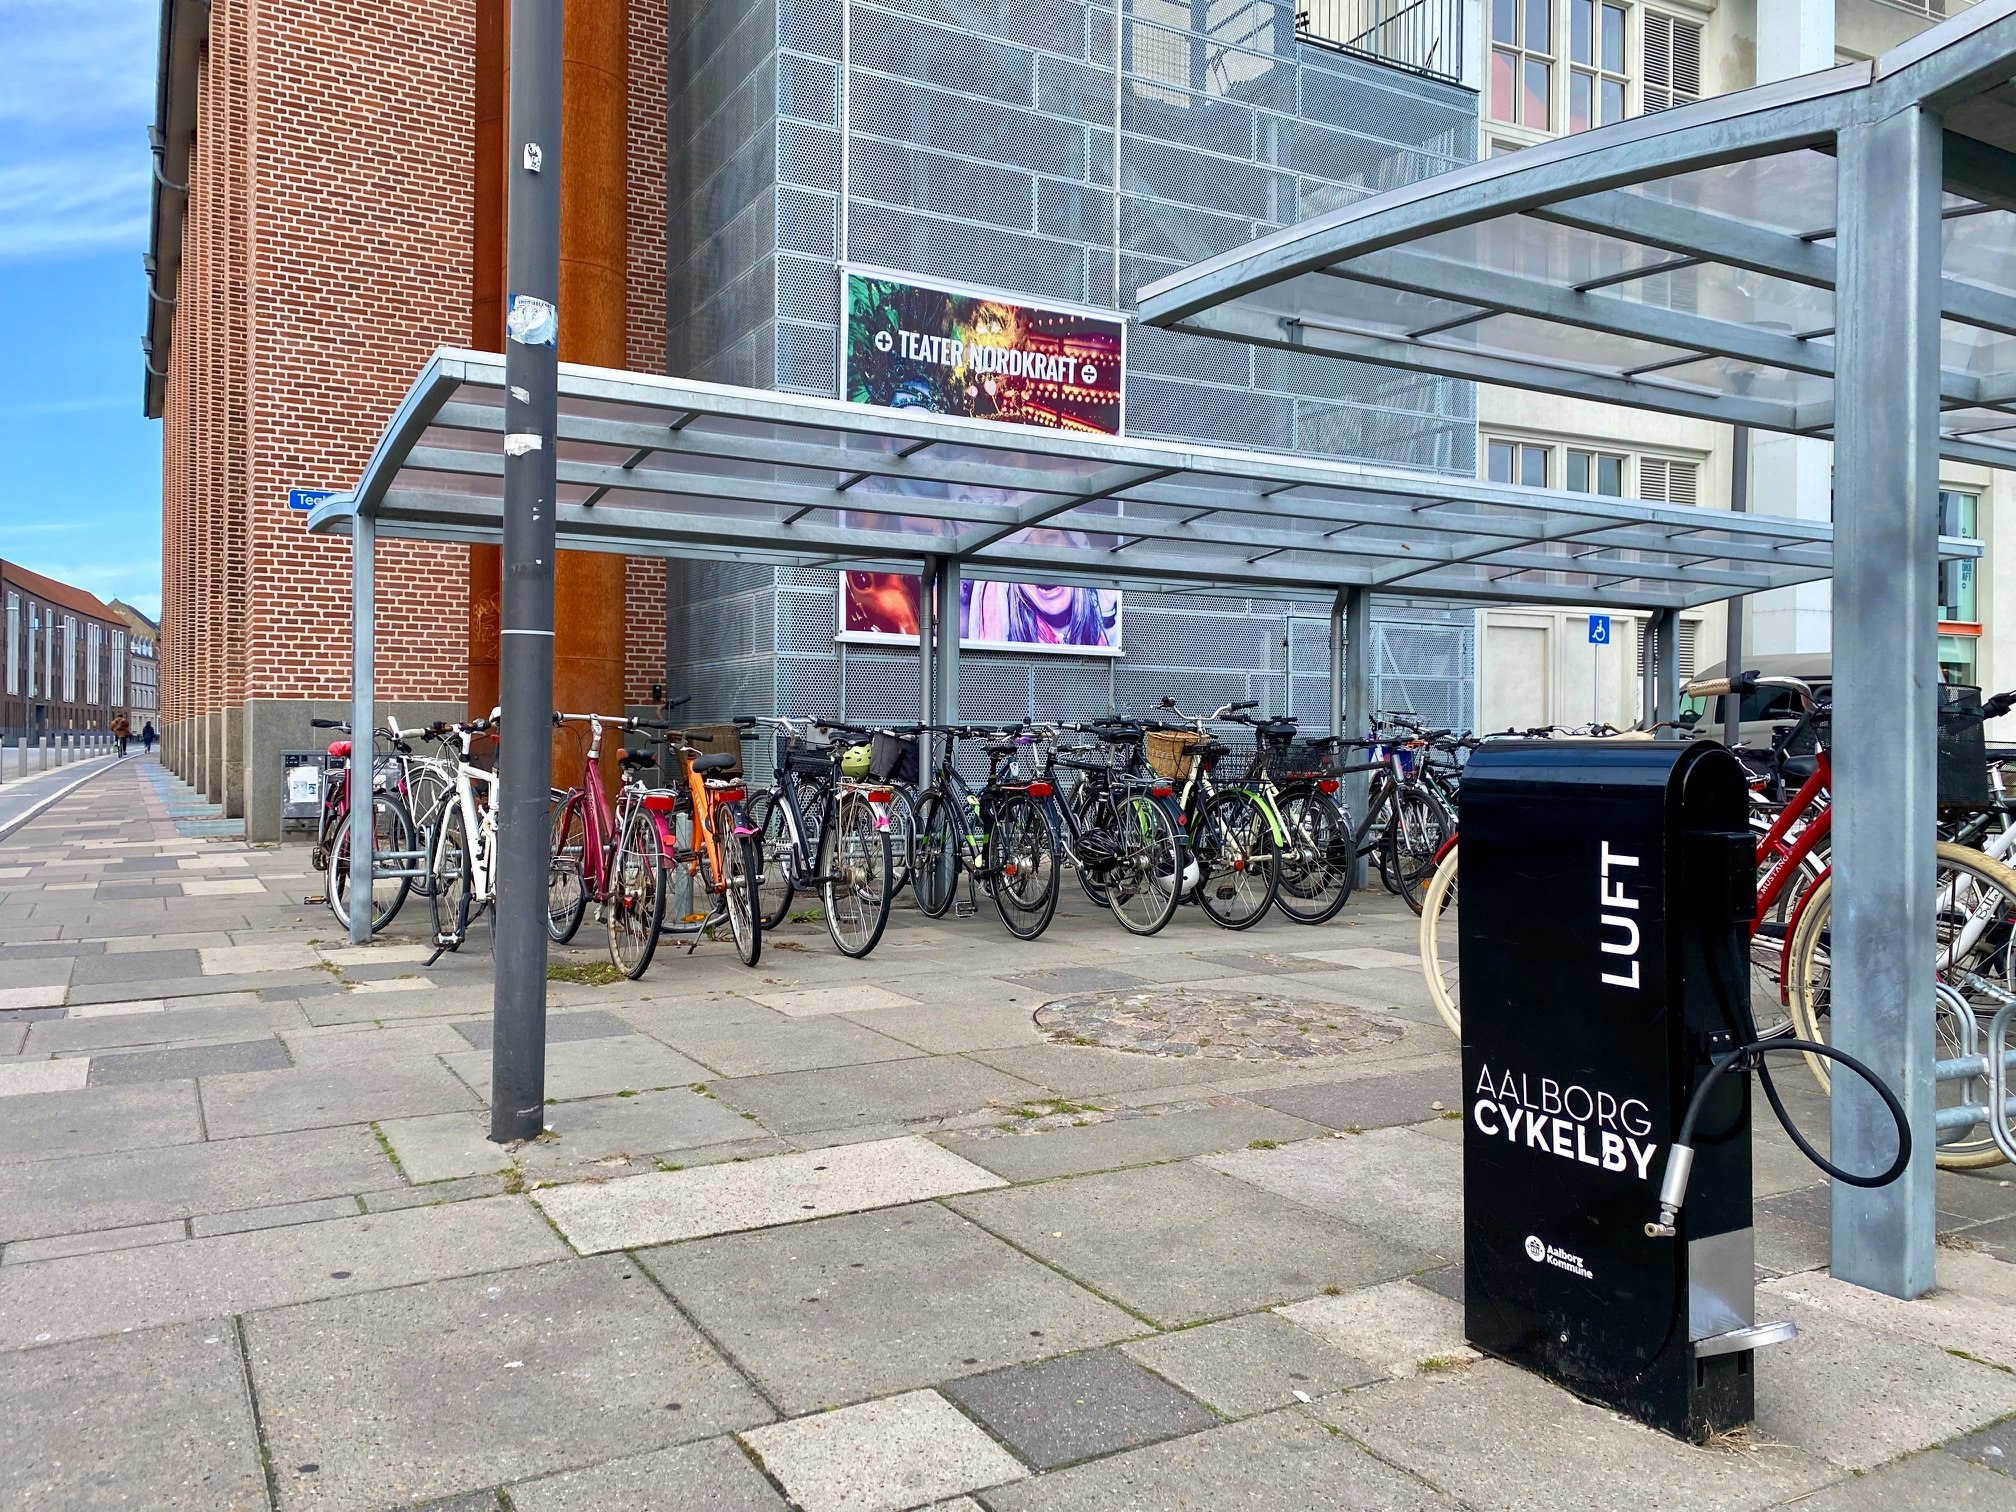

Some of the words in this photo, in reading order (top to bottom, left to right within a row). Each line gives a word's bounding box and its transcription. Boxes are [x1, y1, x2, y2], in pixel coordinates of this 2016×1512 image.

[899, 329, 963, 368] TEATER
[970, 346, 1078, 384] NORDKRAFT
[1760, 854, 1790, 894] MUSTANG
[1601, 841, 1640, 989] LUFT
[1476, 1064, 1653, 1136] AALBORG
[1474, 1099, 1658, 1180] CYKELBY
[1547, 1244, 1584, 1267] Aalborg
[1547, 1254, 1594, 1279] Kommune
